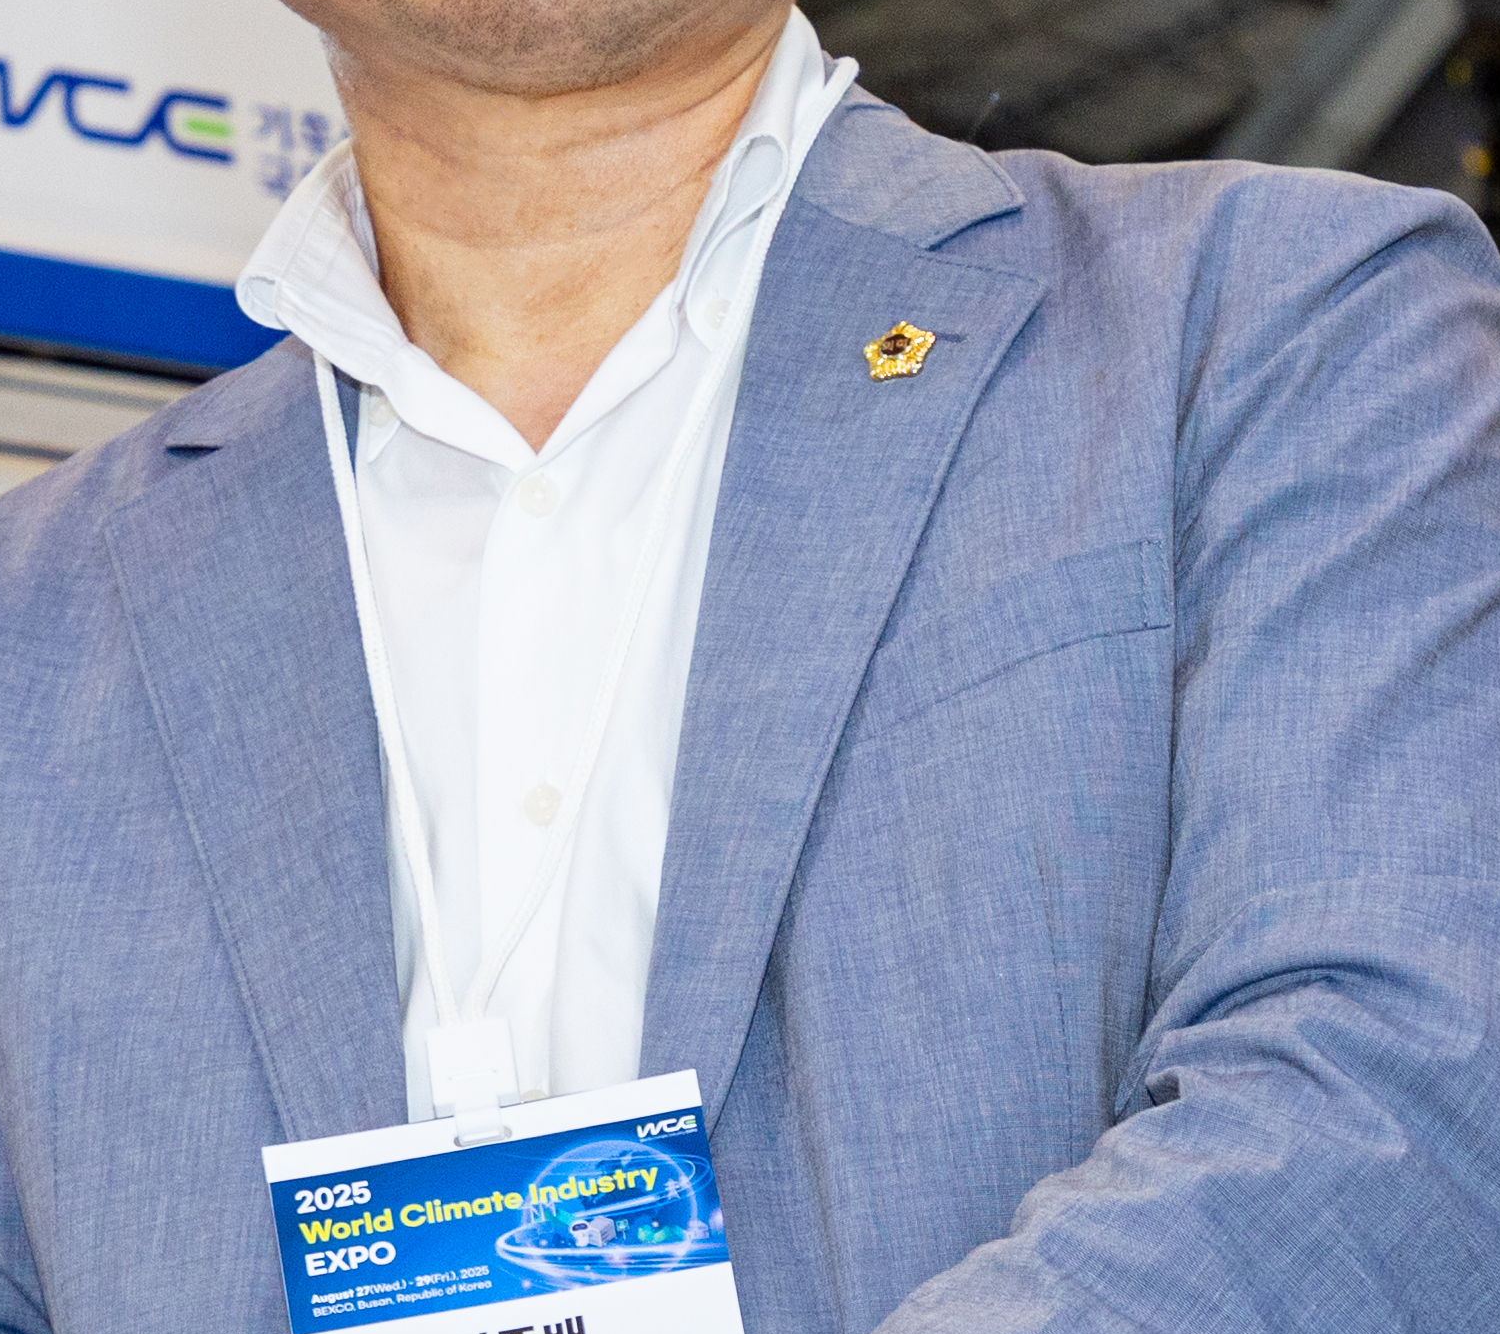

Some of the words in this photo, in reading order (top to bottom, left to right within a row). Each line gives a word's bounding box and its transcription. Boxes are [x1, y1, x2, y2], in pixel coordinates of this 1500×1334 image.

[637, 1115, 698, 1138] WCE
[294, 1180, 372, 1215] 2025
[299, 1208, 394, 1244] World
[400, 1190, 524, 1227] Climate
[529, 1166, 659, 1207] Industry
[304, 1240, 397, 1277] EXPO
[311, 1289, 355, 1305] August
[356, 1278, 407, 1296] 27(Wed.)
[459, 1265, 490, 1279] 2025
[396, 1286, 444, 1303] Republic
[446, 1283, 458, 1295] of
[458, 1279, 492, 1293] Korea
